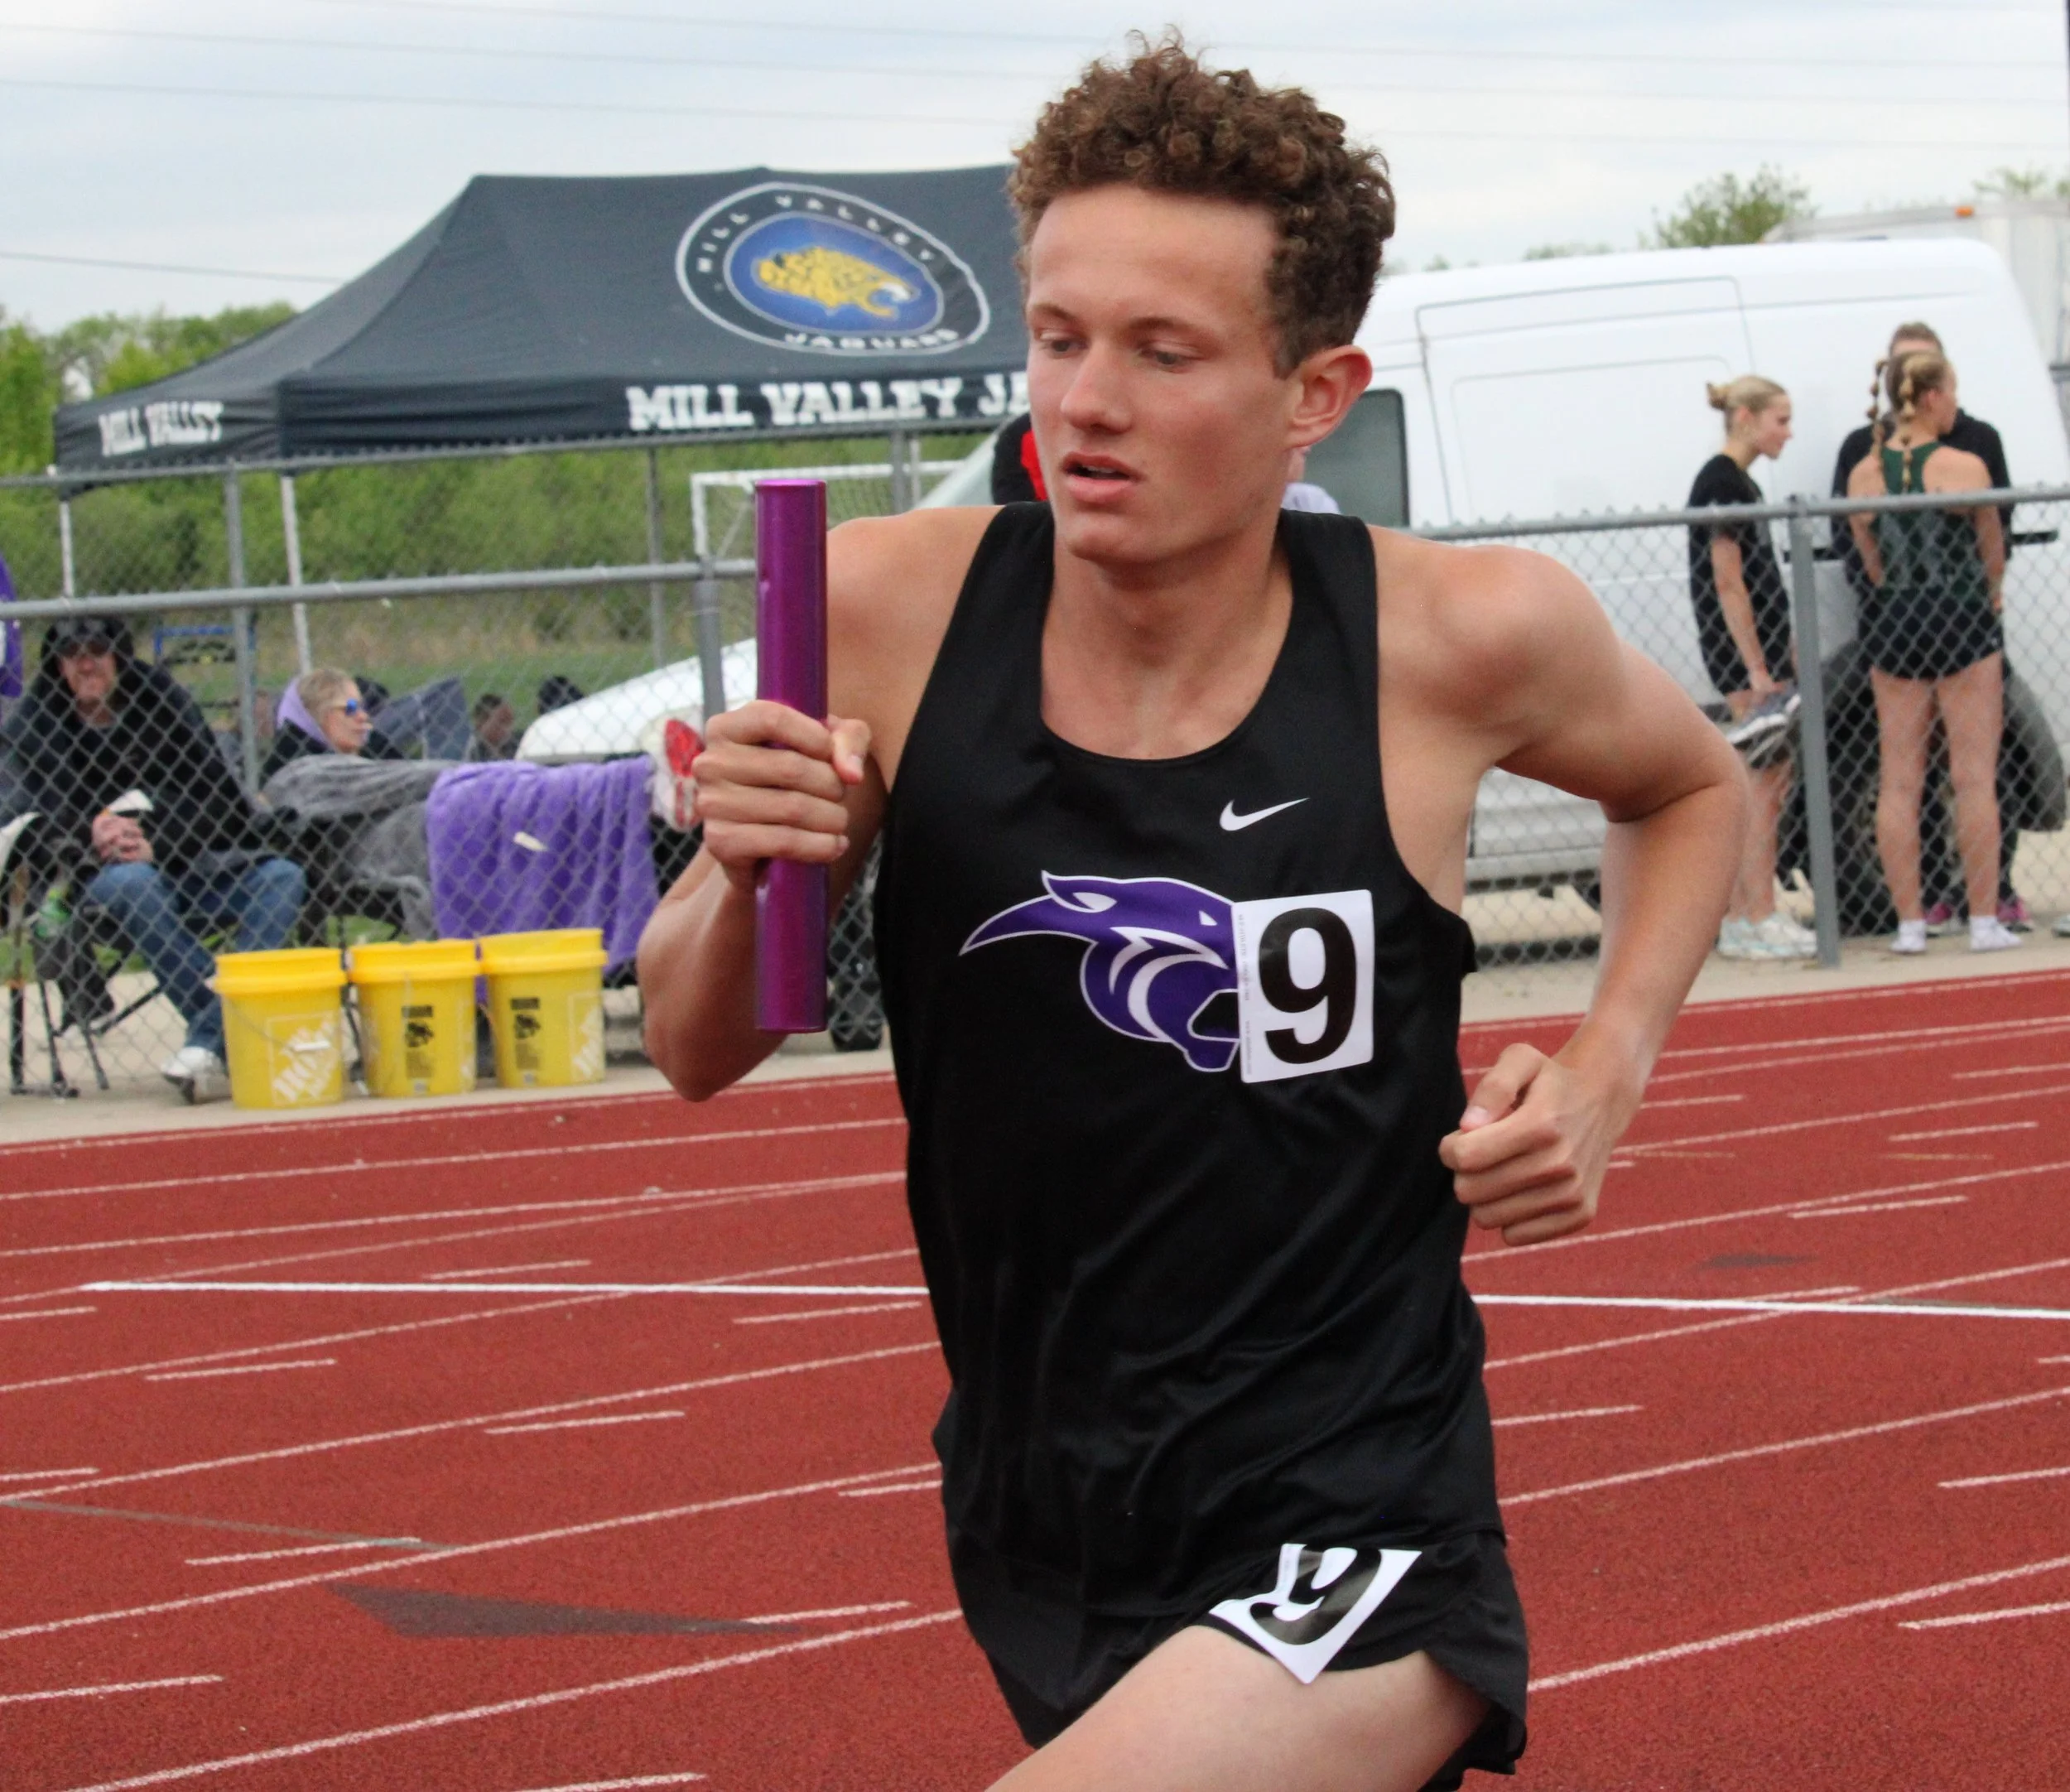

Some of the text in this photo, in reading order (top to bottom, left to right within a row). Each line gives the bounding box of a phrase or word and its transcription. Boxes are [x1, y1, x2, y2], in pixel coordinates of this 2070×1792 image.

[627, 386, 753, 430] MILL
[761, 378, 962, 426] VALLEY
[1258, 907, 1358, 1065] 9
